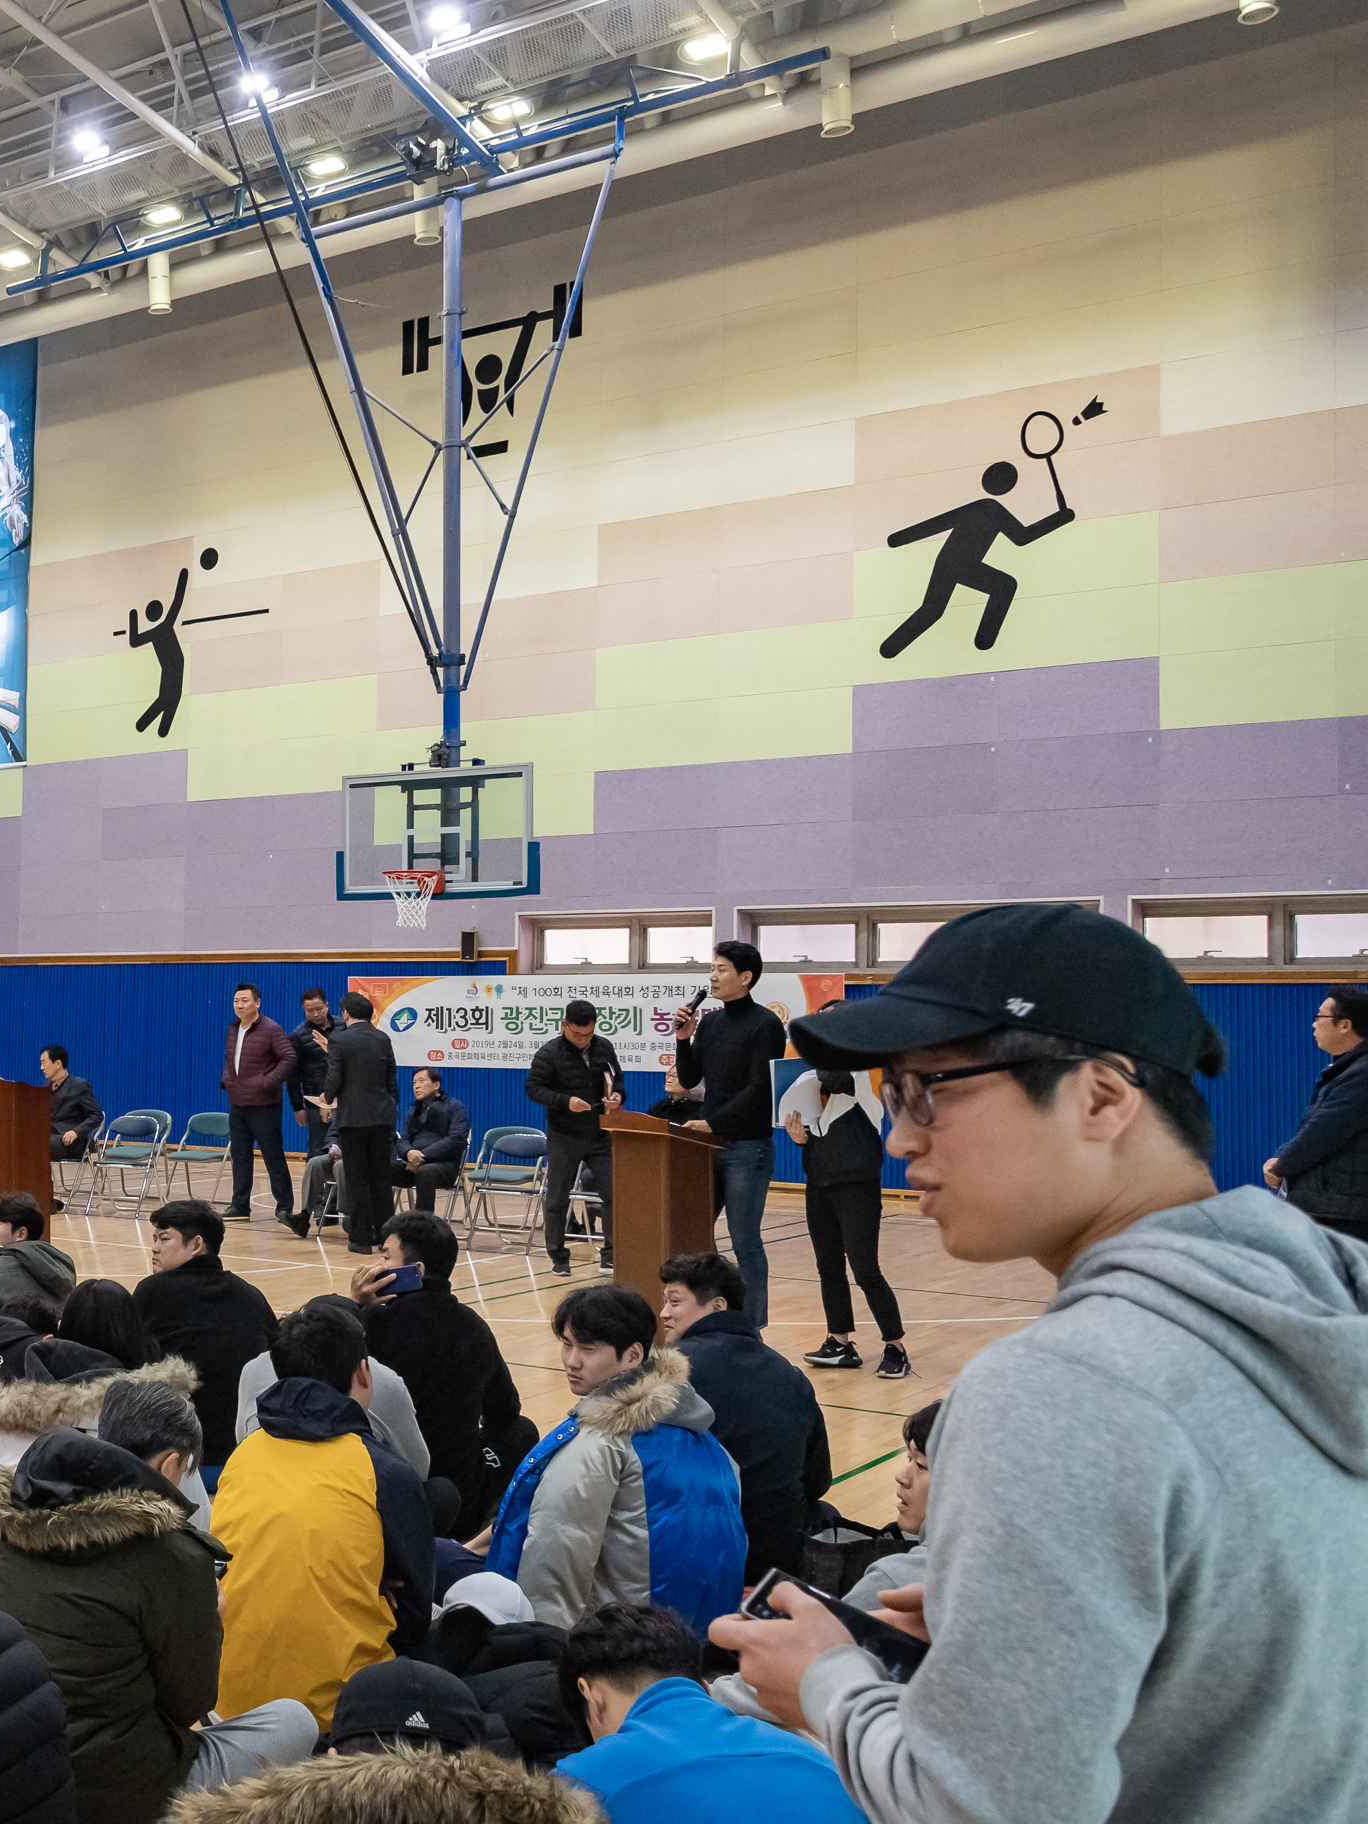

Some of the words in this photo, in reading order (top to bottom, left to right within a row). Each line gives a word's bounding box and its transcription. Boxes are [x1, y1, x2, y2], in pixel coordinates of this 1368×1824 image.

[532, 986, 563, 999] 100회
[567, 985, 634, 999] 전국체육대회
[639, 985, 686, 999] 성공개최
[423, 1006, 492, 1033] 제13회
[500, 1006, 643, 1035] 광진구장기
[454, 1039, 468, 1048] 일시
[471, 1040, 495, 1048] 2019년
[429, 1052, 443, 1060] 장소
[405, 1720, 430, 1729] adidas
